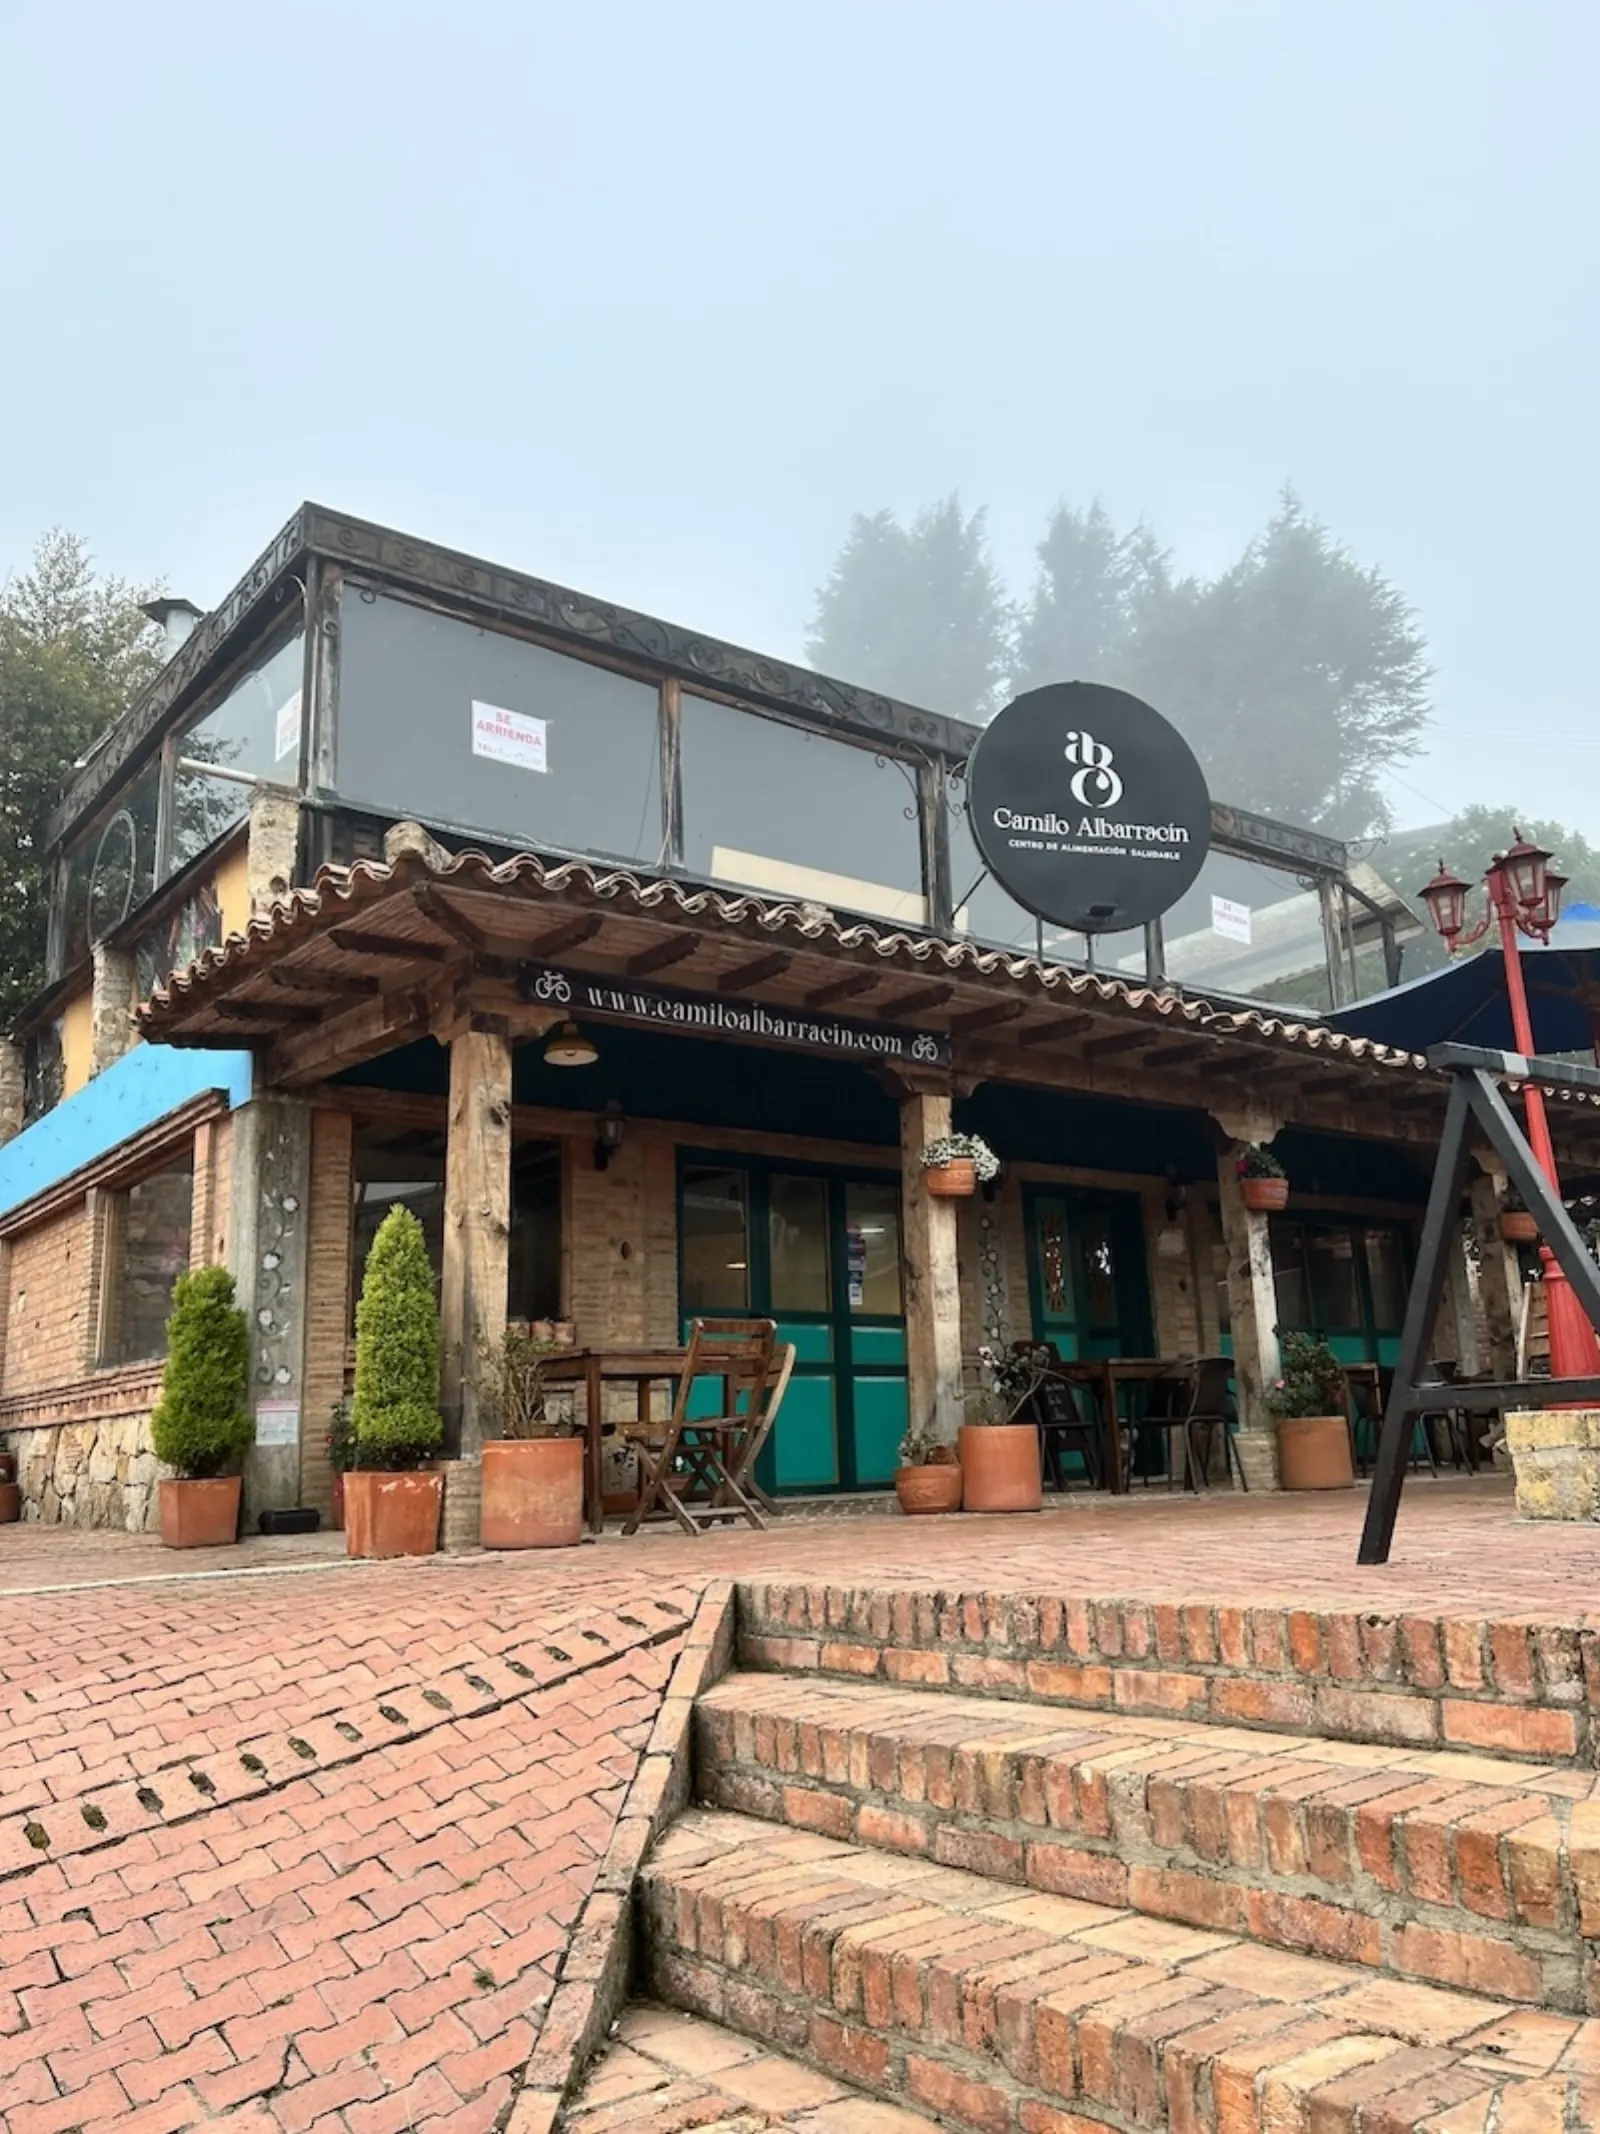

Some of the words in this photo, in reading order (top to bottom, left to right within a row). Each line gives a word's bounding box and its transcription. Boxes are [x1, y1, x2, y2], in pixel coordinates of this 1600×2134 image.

[476, 719, 543, 746] ARRIENDA
[993, 807, 1070, 835] Camilo
[1076, 816, 1190, 843] Albarracín
[1008, 839, 1044, 850] CENTRO
[1046, 841, 1058, 851] DE
[1060, 843, 1127, 856] ALIMENTACIÓN
[1131, 848, 1181, 861] SALUDABLE
[587, 986, 902, 1055] www.camiloalbarracin.com
